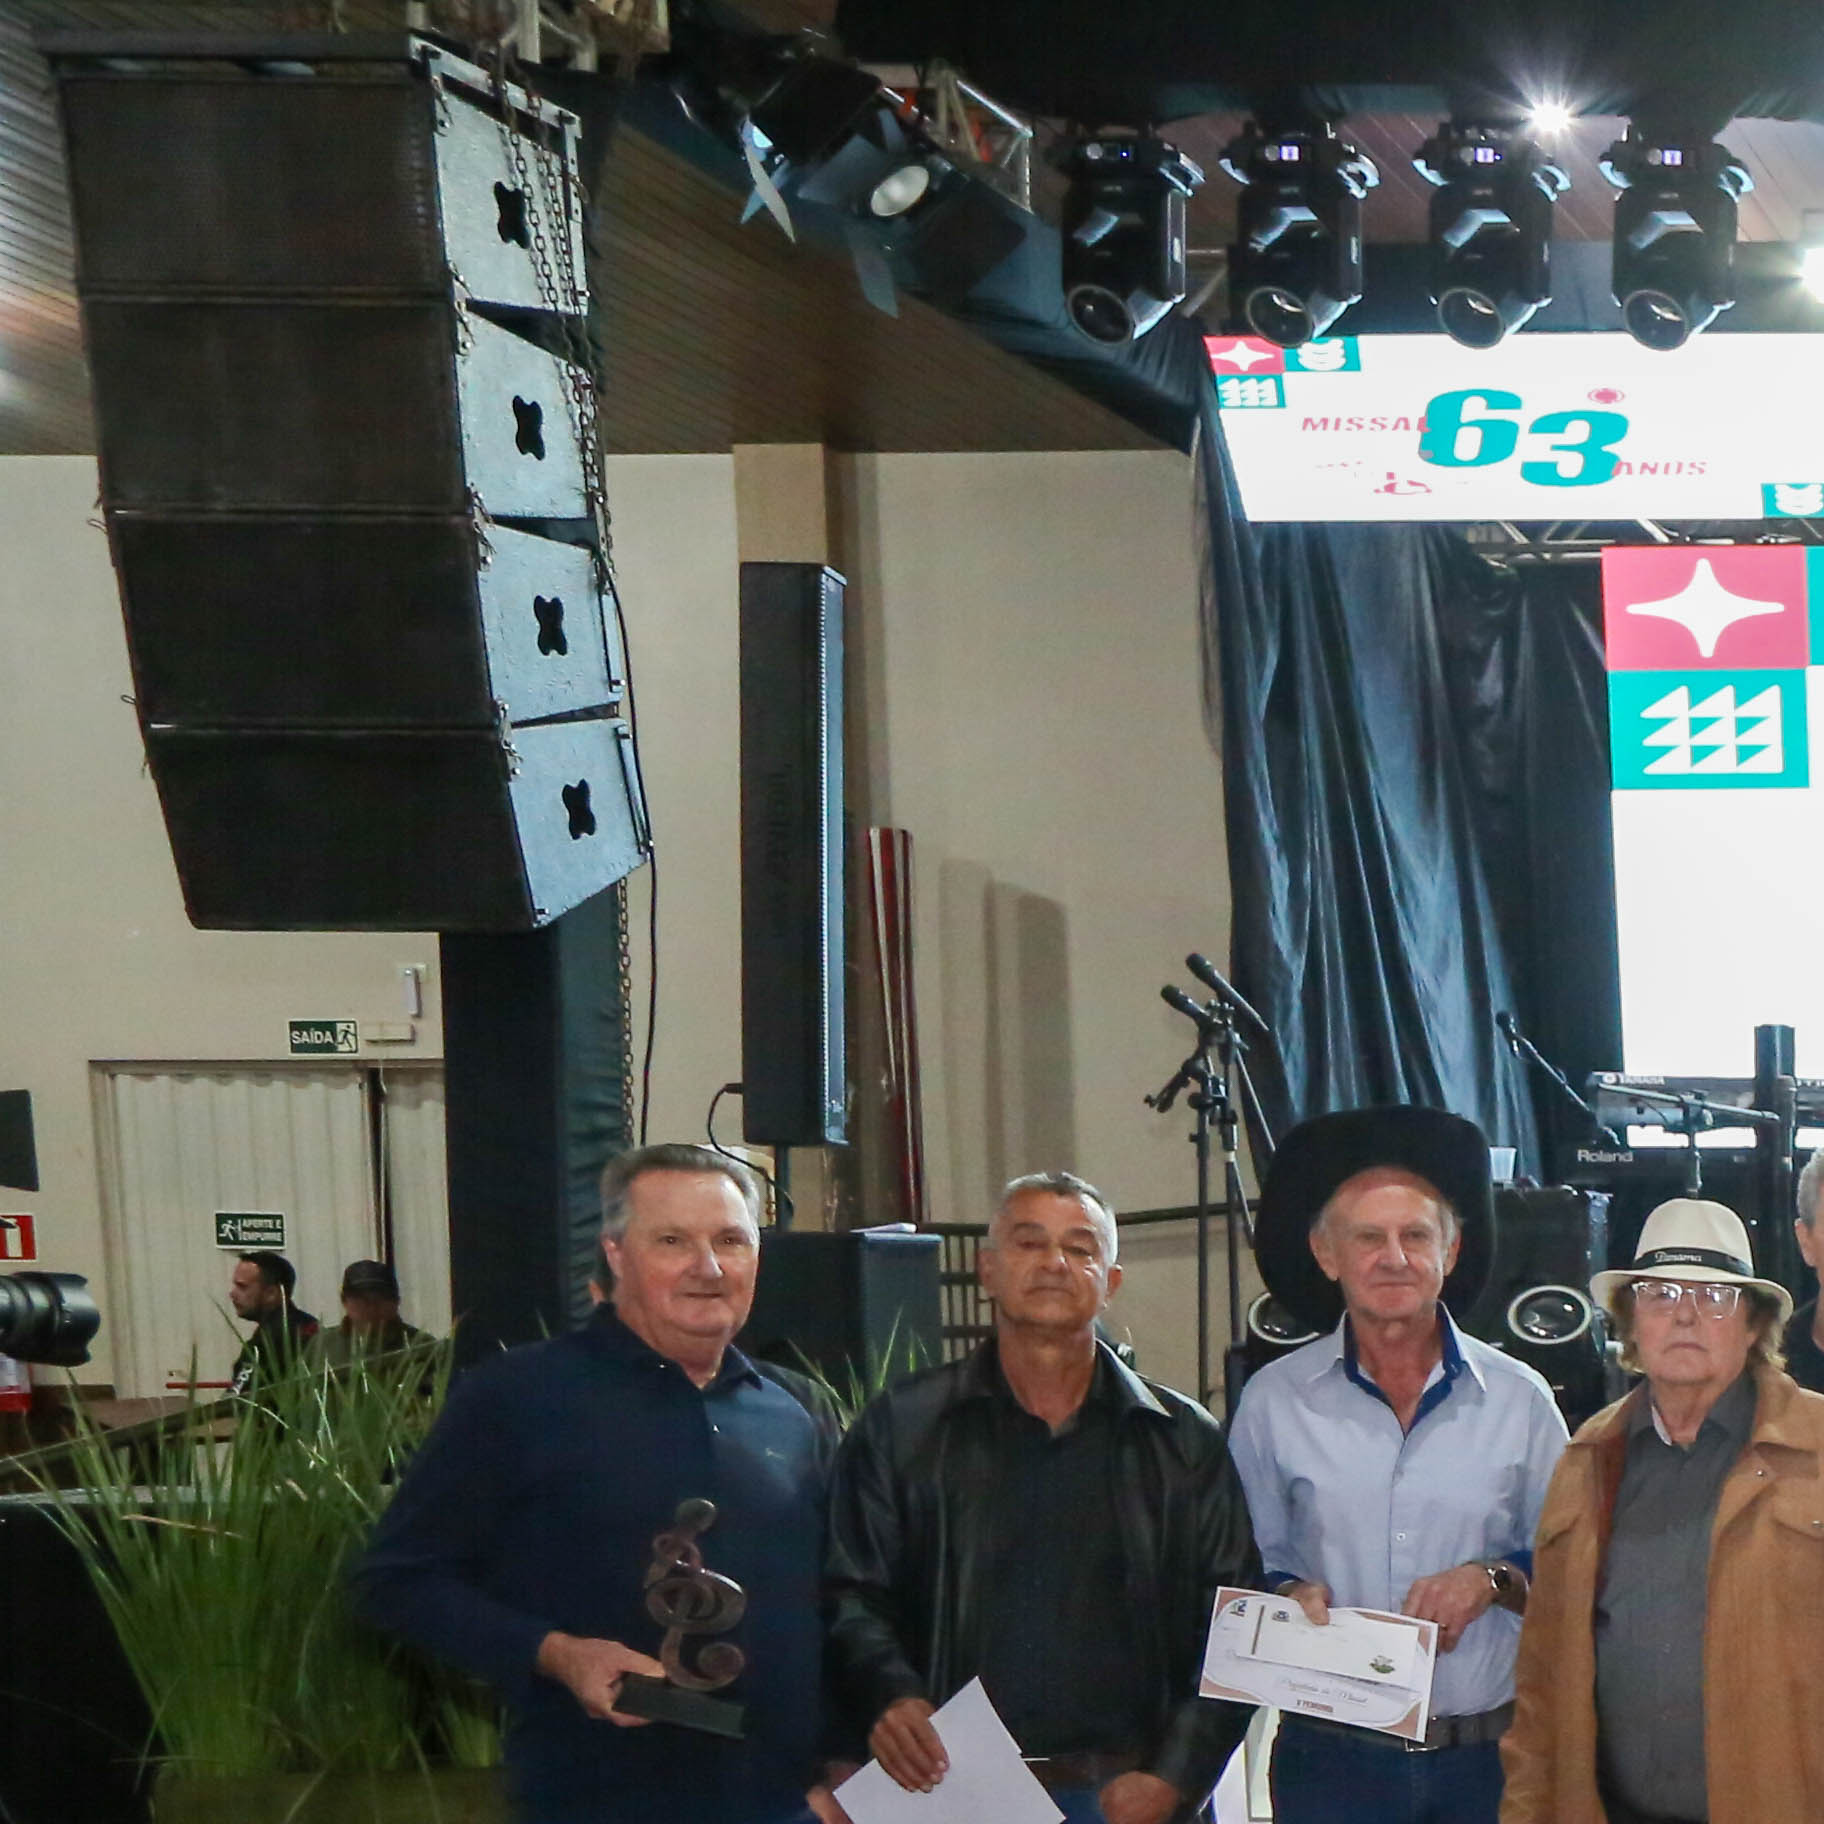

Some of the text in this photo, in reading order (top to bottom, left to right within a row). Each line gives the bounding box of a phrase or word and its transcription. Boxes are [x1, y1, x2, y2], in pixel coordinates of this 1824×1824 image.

[1302, 415, 1431, 433] MISSAL
[1417, 388, 1629, 488] 63
[291, 1027, 334, 1044] SAÍDA
[1577, 1149, 1633, 1162] Roland
